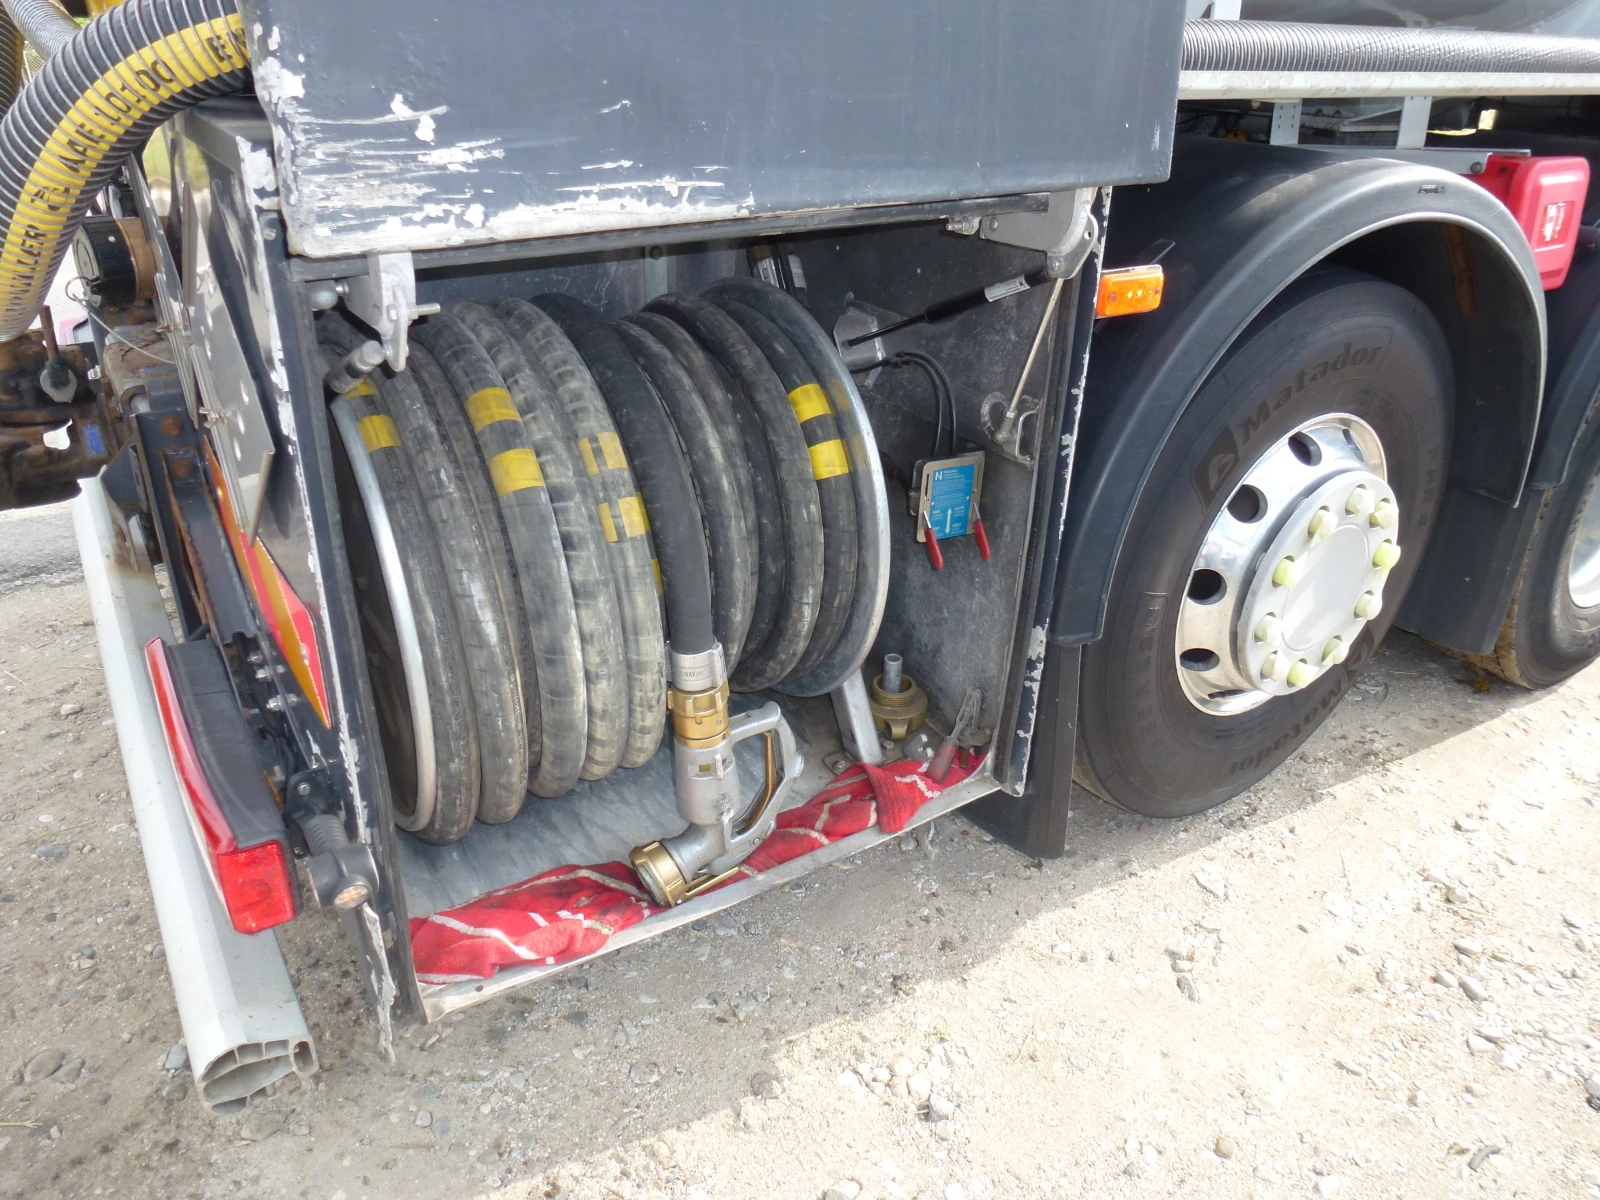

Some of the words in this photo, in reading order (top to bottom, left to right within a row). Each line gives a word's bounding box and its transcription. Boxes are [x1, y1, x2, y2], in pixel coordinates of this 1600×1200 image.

[57, 121, 107, 174] AAE
[94, 58, 177, 127] 10100
[1239, 341, 1383, 447] Matador
